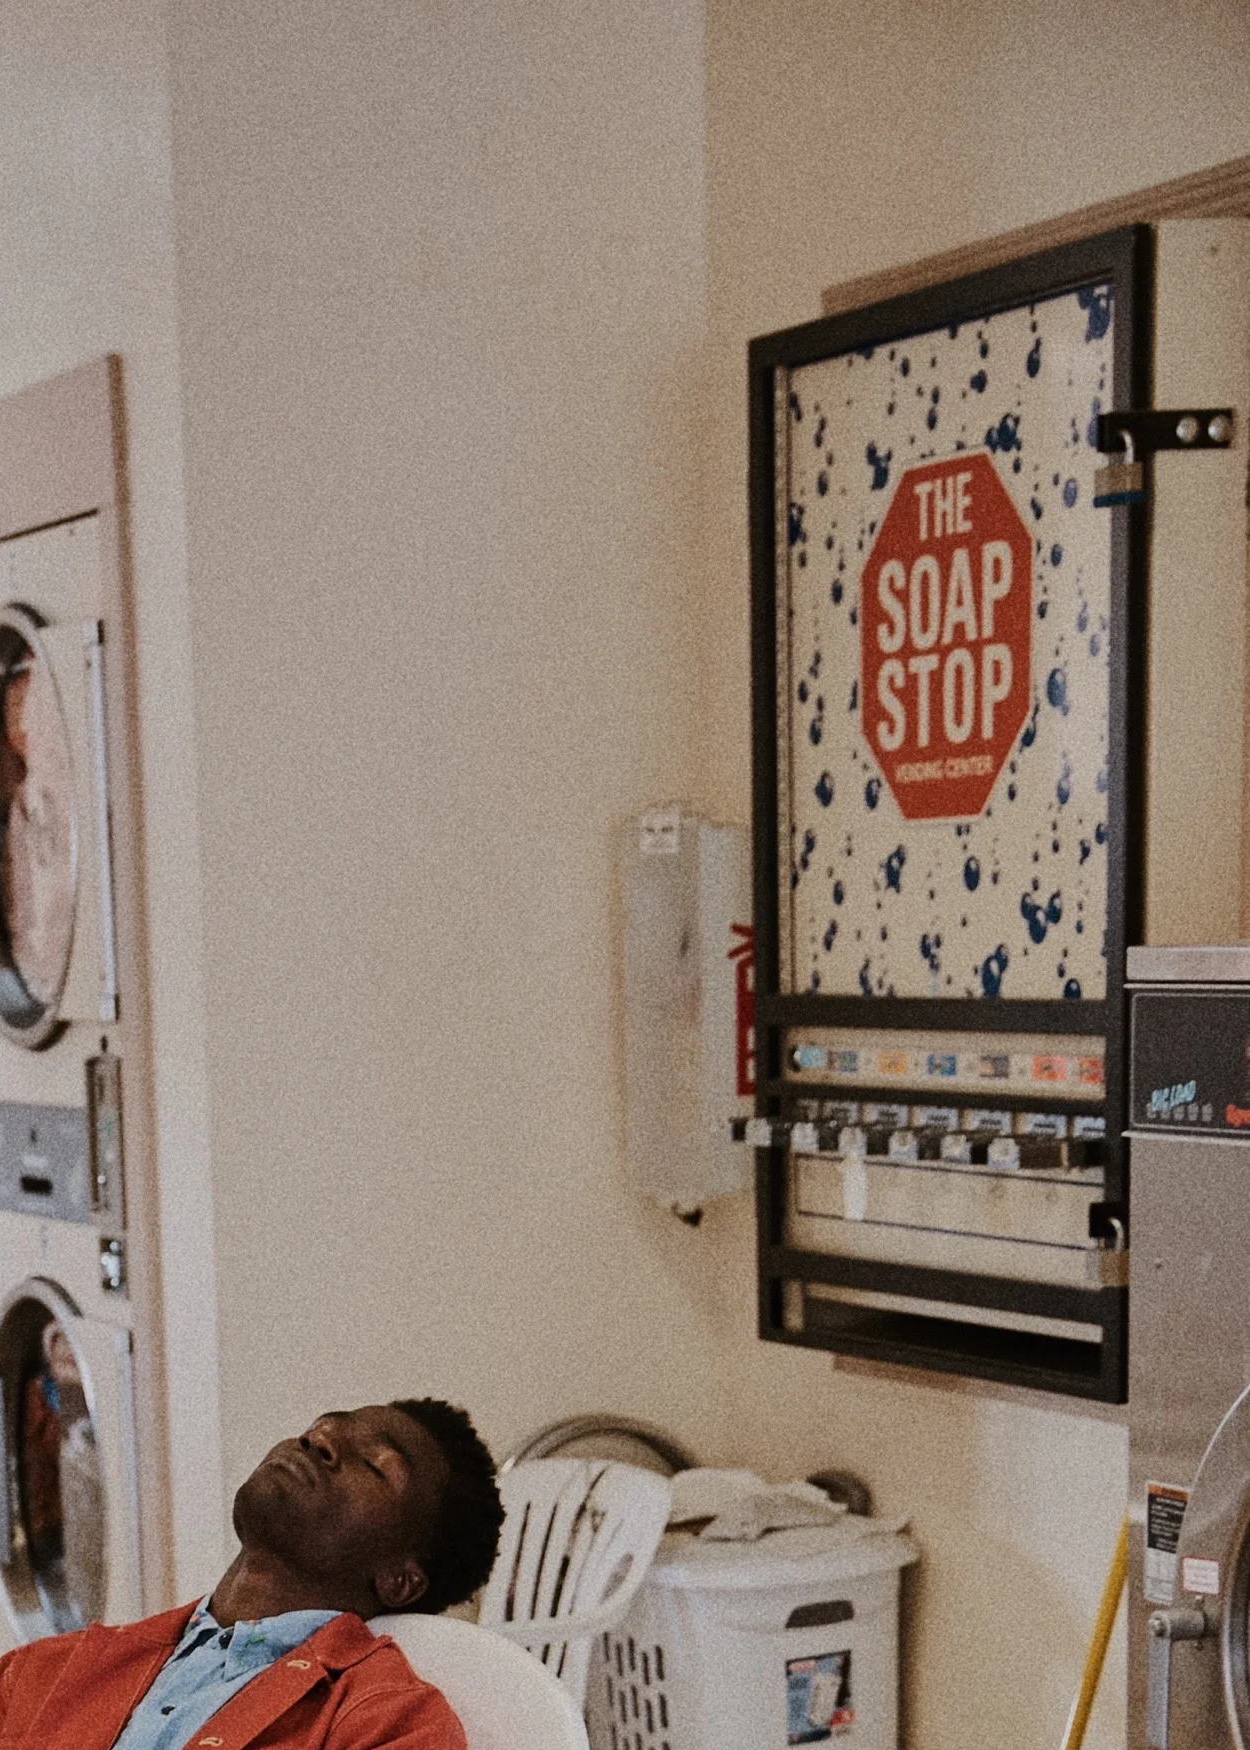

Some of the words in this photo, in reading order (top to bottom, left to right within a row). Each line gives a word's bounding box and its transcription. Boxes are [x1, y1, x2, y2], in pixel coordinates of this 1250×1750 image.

[914, 471, 973, 543] THE
[877, 540, 1014, 654] SOAP
[877, 643, 1014, 752] STOP
[944, 755, 992, 779] CENTER
